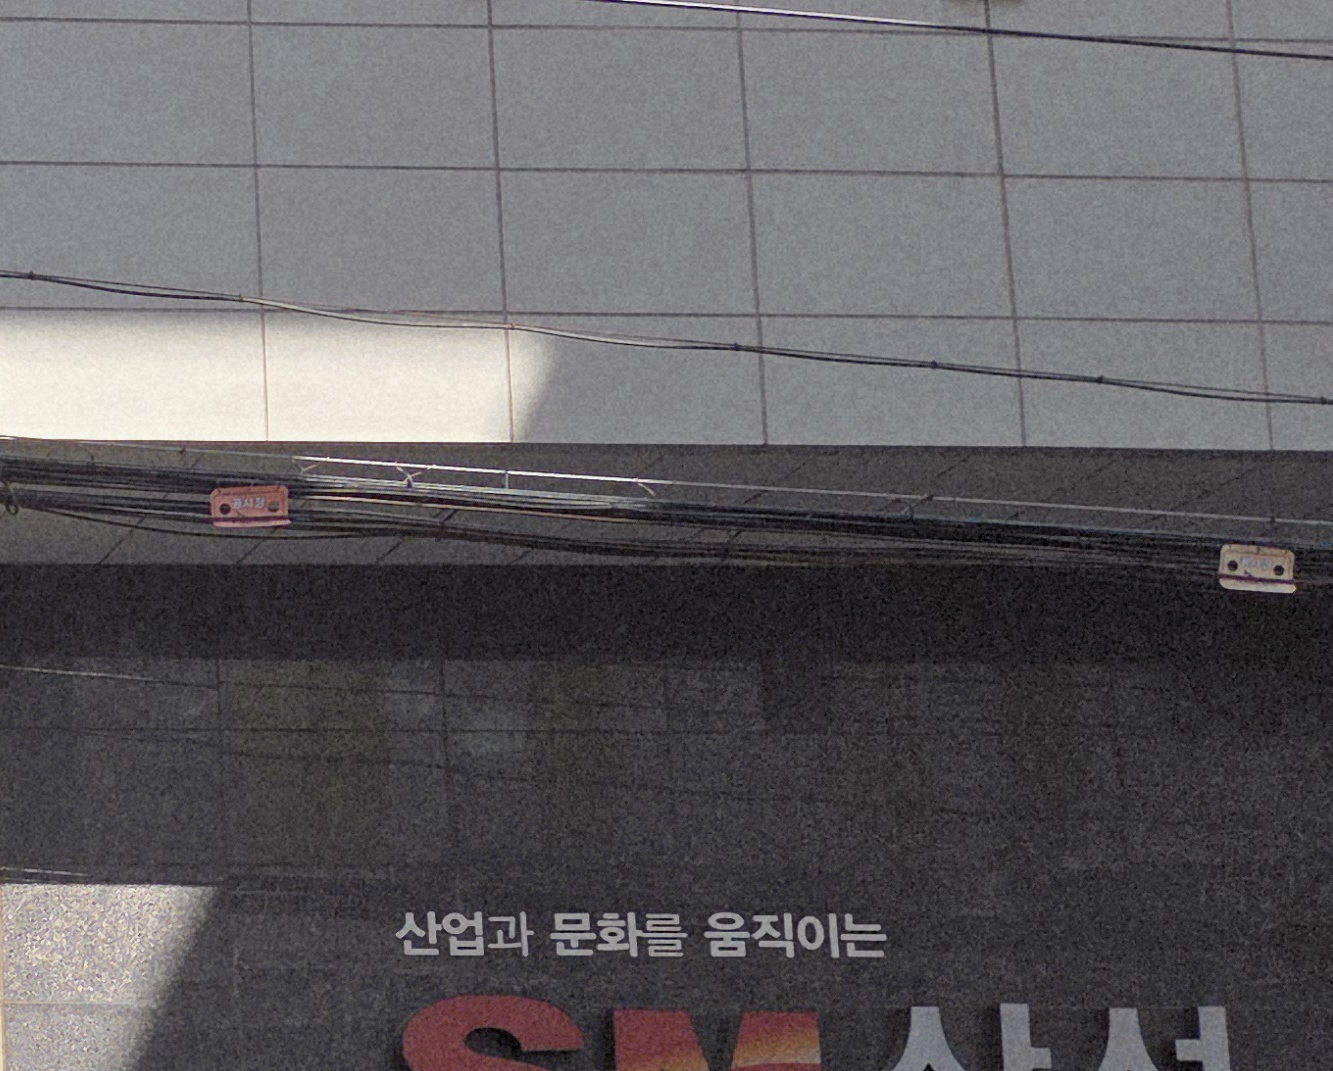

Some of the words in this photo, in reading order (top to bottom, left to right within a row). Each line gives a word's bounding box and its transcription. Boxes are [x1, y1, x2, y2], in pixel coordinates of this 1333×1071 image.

[395, 911, 534, 957] 산업과
[549, 911, 688, 957] 문화를
[703, 911, 888, 958] 움직이는
